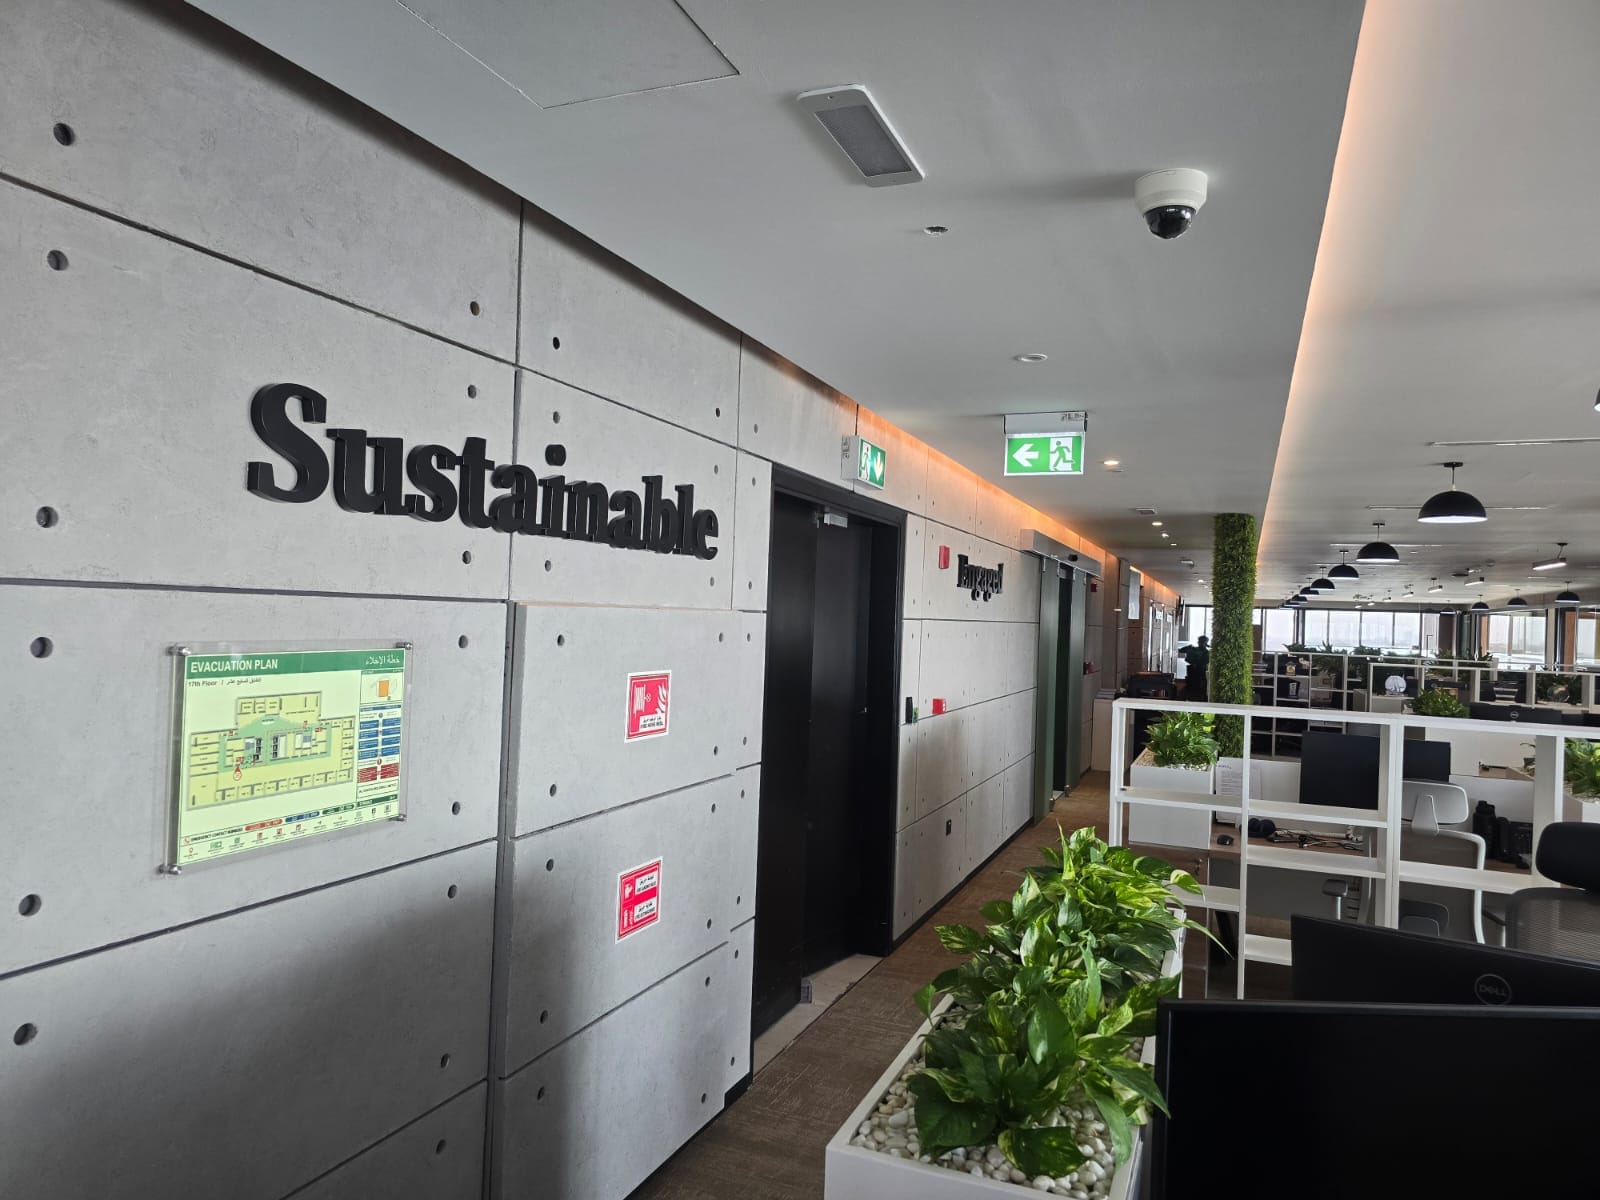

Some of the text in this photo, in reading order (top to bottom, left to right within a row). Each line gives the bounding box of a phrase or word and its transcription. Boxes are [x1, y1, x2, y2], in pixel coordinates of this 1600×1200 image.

[247, 382, 719, 560] Sustainable
[957, 554, 1004, 602] Engaged
[191, 659, 278, 672] EVACUATION PLAN
[1479, 984, 1507, 997] DELL
